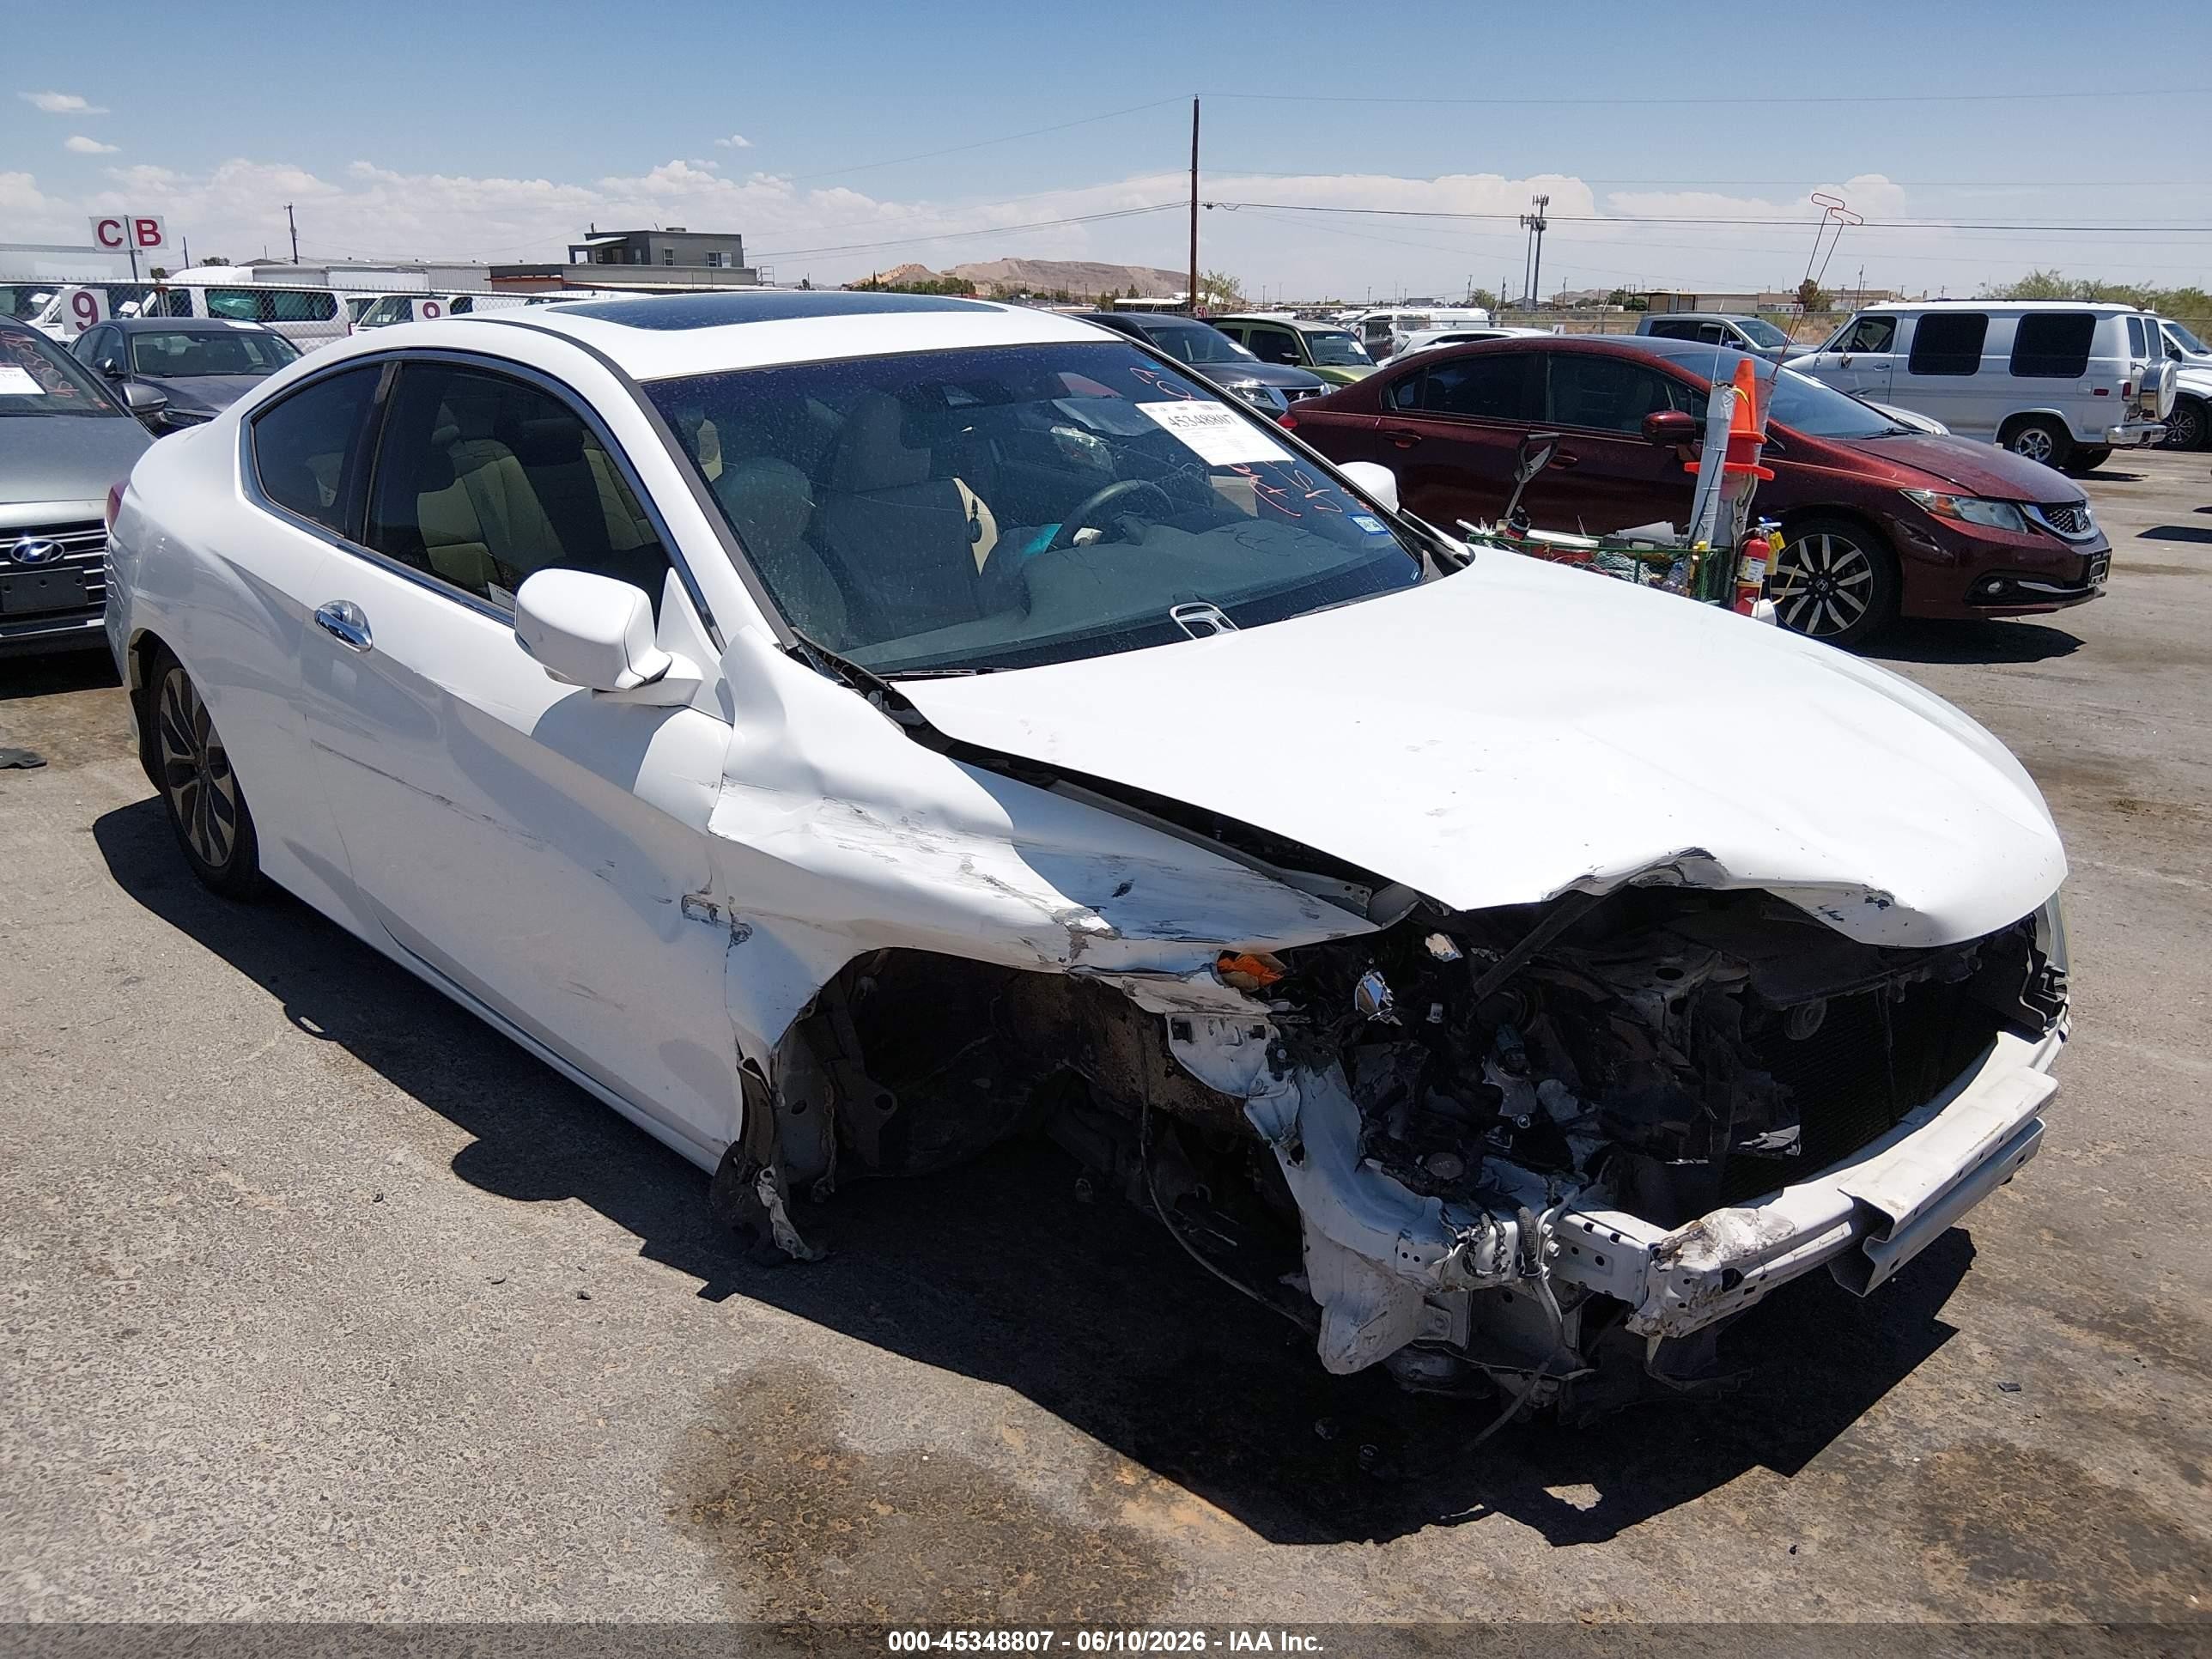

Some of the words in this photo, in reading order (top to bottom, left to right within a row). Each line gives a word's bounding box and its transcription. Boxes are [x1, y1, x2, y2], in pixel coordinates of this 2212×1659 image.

[97, 219, 124, 247] C
[135, 219, 161, 246] B
[72, 291, 99, 331] 9
[1167, 414, 1238, 428] 45348807
